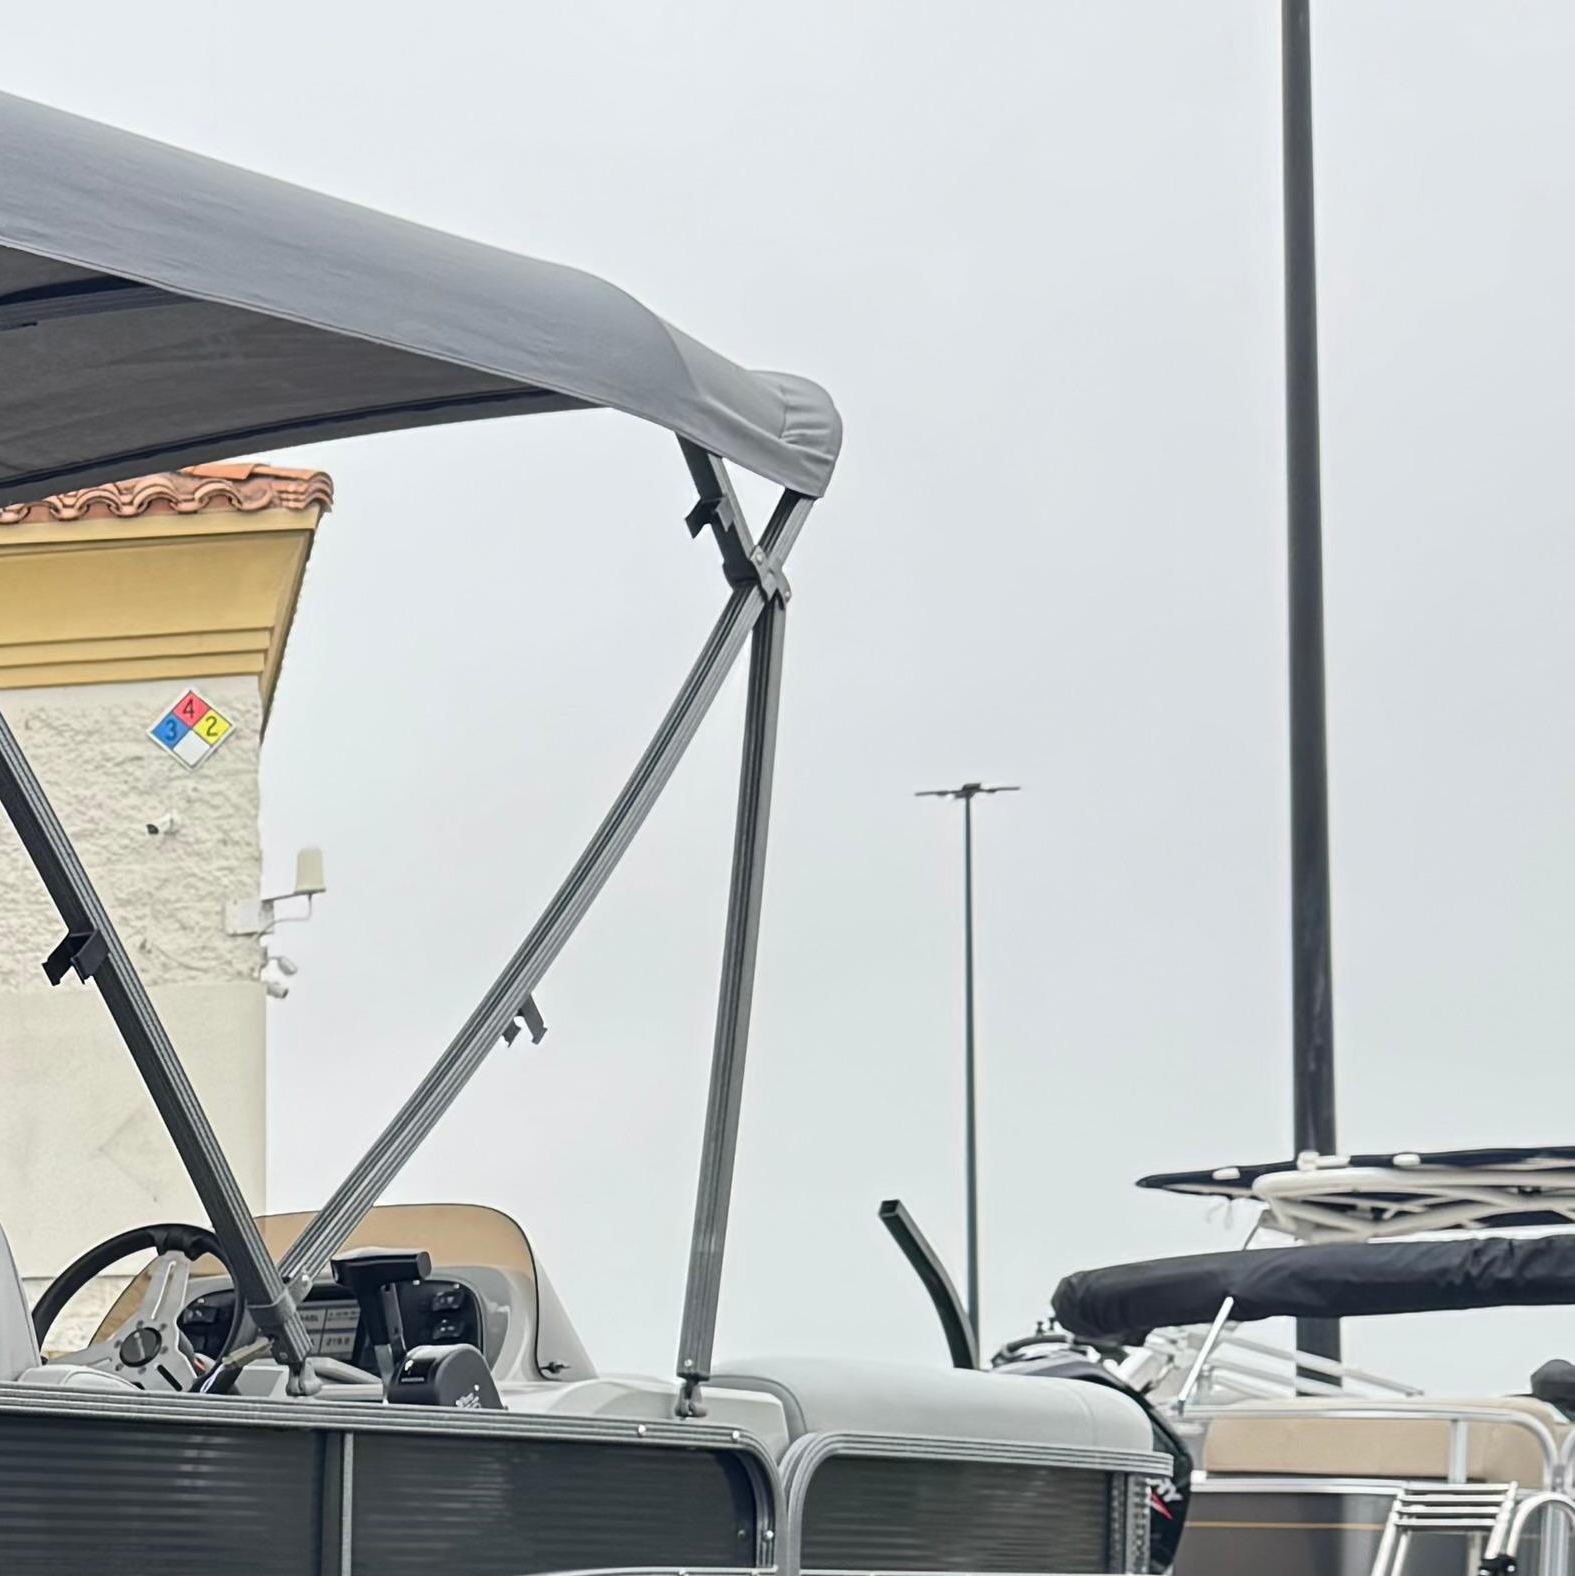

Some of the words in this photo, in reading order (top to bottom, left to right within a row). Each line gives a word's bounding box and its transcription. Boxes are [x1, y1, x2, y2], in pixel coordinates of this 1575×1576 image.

[183, 698, 195, 718] 4
[166, 719, 178, 741] 3
[206, 716, 218, 737] 2
